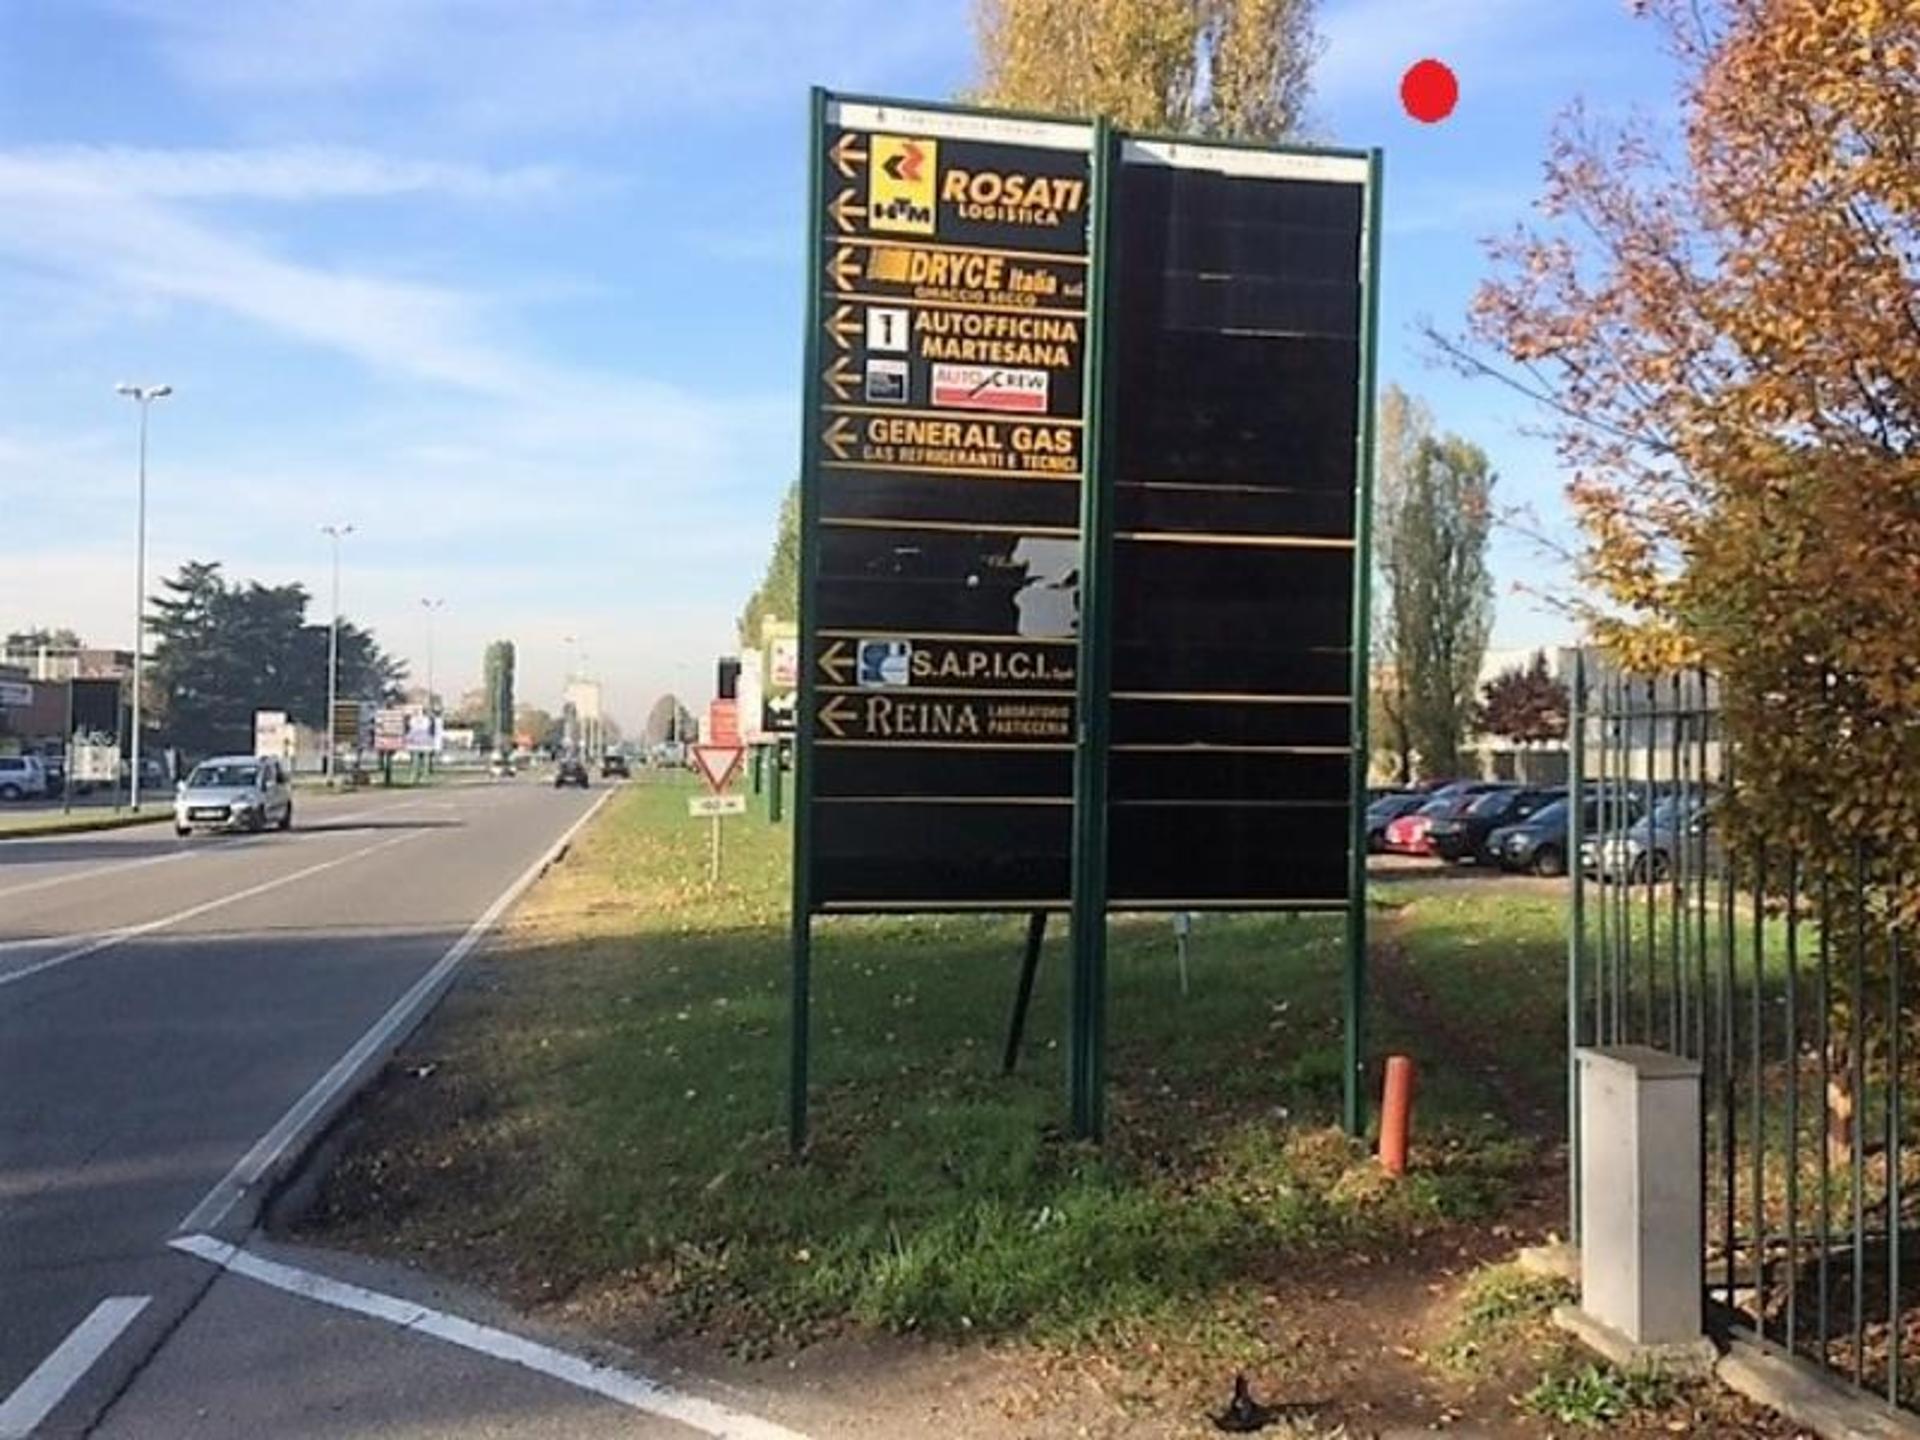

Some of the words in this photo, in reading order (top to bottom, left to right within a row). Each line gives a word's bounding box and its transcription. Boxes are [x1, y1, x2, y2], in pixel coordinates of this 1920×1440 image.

[941, 169, 1083, 212] ROSATI
[959, 203, 1058, 226] LOGISTICA
[910, 252, 1004, 289] DRYCE
[1008, 268, 1057, 294] Italia
[914, 310, 1079, 343] AUTOFFICINA
[922, 337, 1070, 367] MARTESANA
[991, 371, 1045, 389] CREW
[868, 419, 1003, 449] GENERAL
[1011, 428, 1074, 453] GAS
